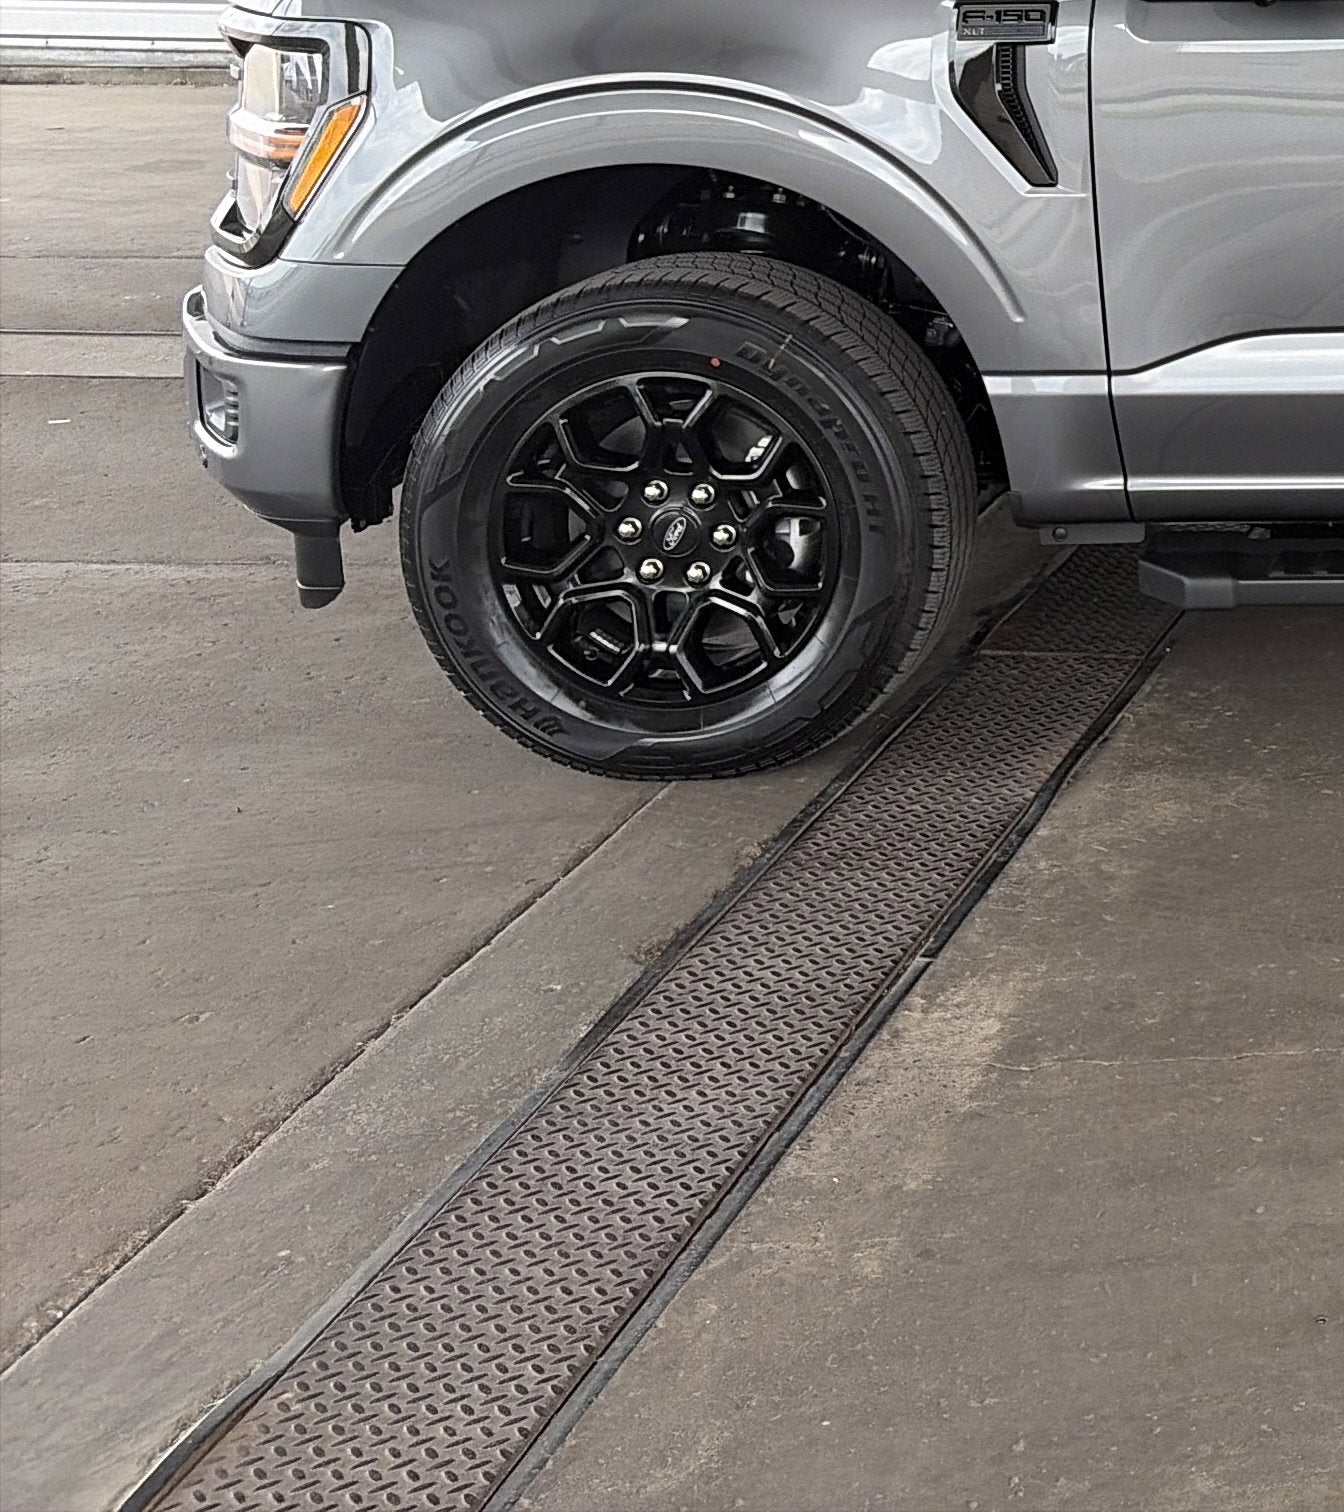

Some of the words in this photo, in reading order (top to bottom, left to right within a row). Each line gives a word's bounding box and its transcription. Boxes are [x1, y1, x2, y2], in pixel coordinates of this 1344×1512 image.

[962, 9, 1047, 25] F-150
[963, 28, 985, 36] XLT
[664, 519, 686, 549] Ford
